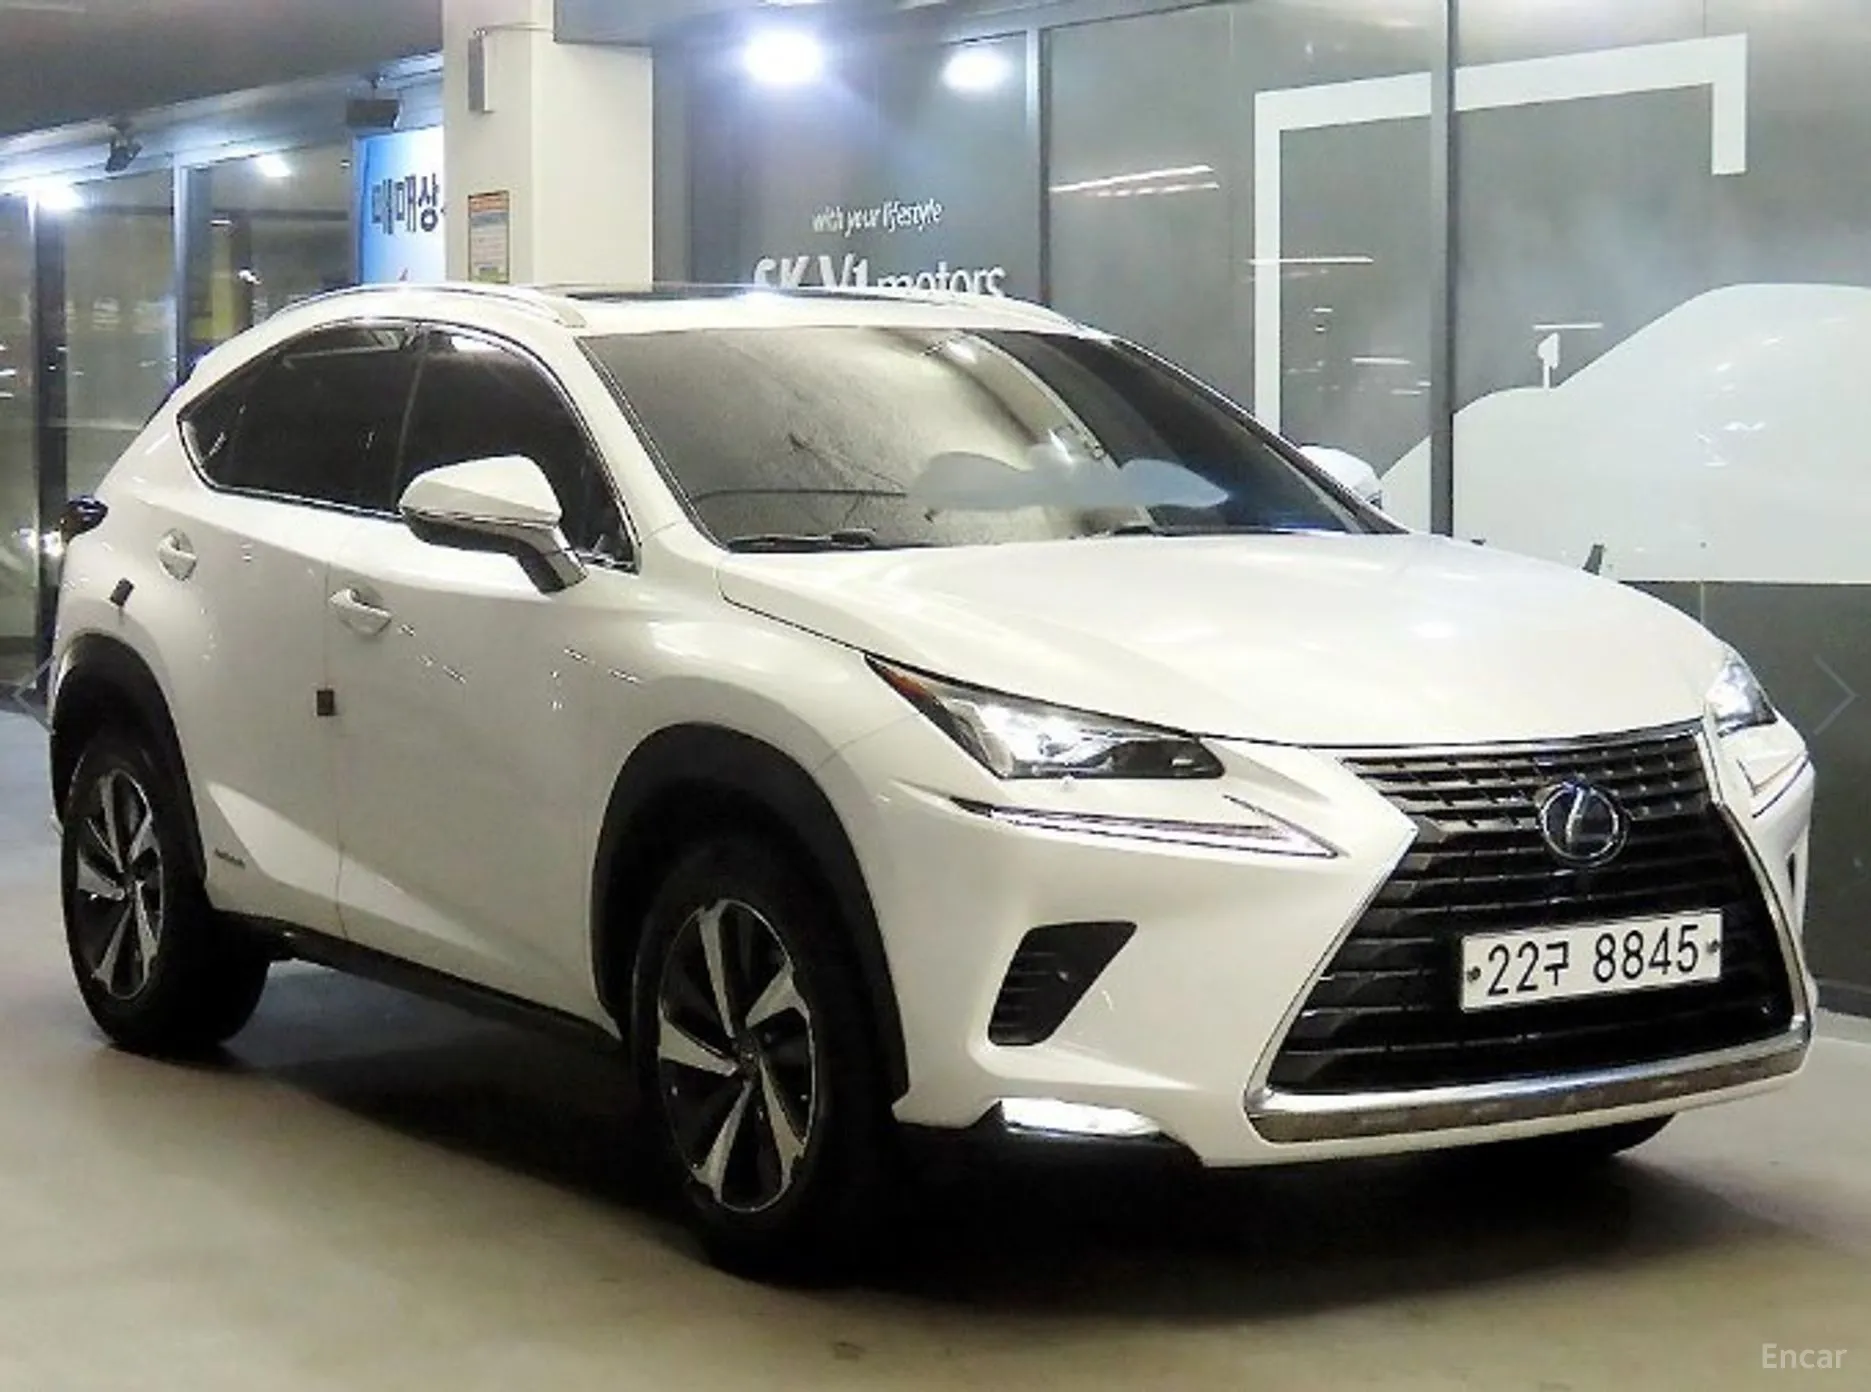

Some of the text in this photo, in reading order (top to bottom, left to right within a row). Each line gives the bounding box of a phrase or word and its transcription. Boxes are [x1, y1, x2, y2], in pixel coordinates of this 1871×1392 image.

[372, 173, 445, 235] 매매상
[844, 208, 881, 238] your
[1487, 924, 1699, 997] 22구 8845
